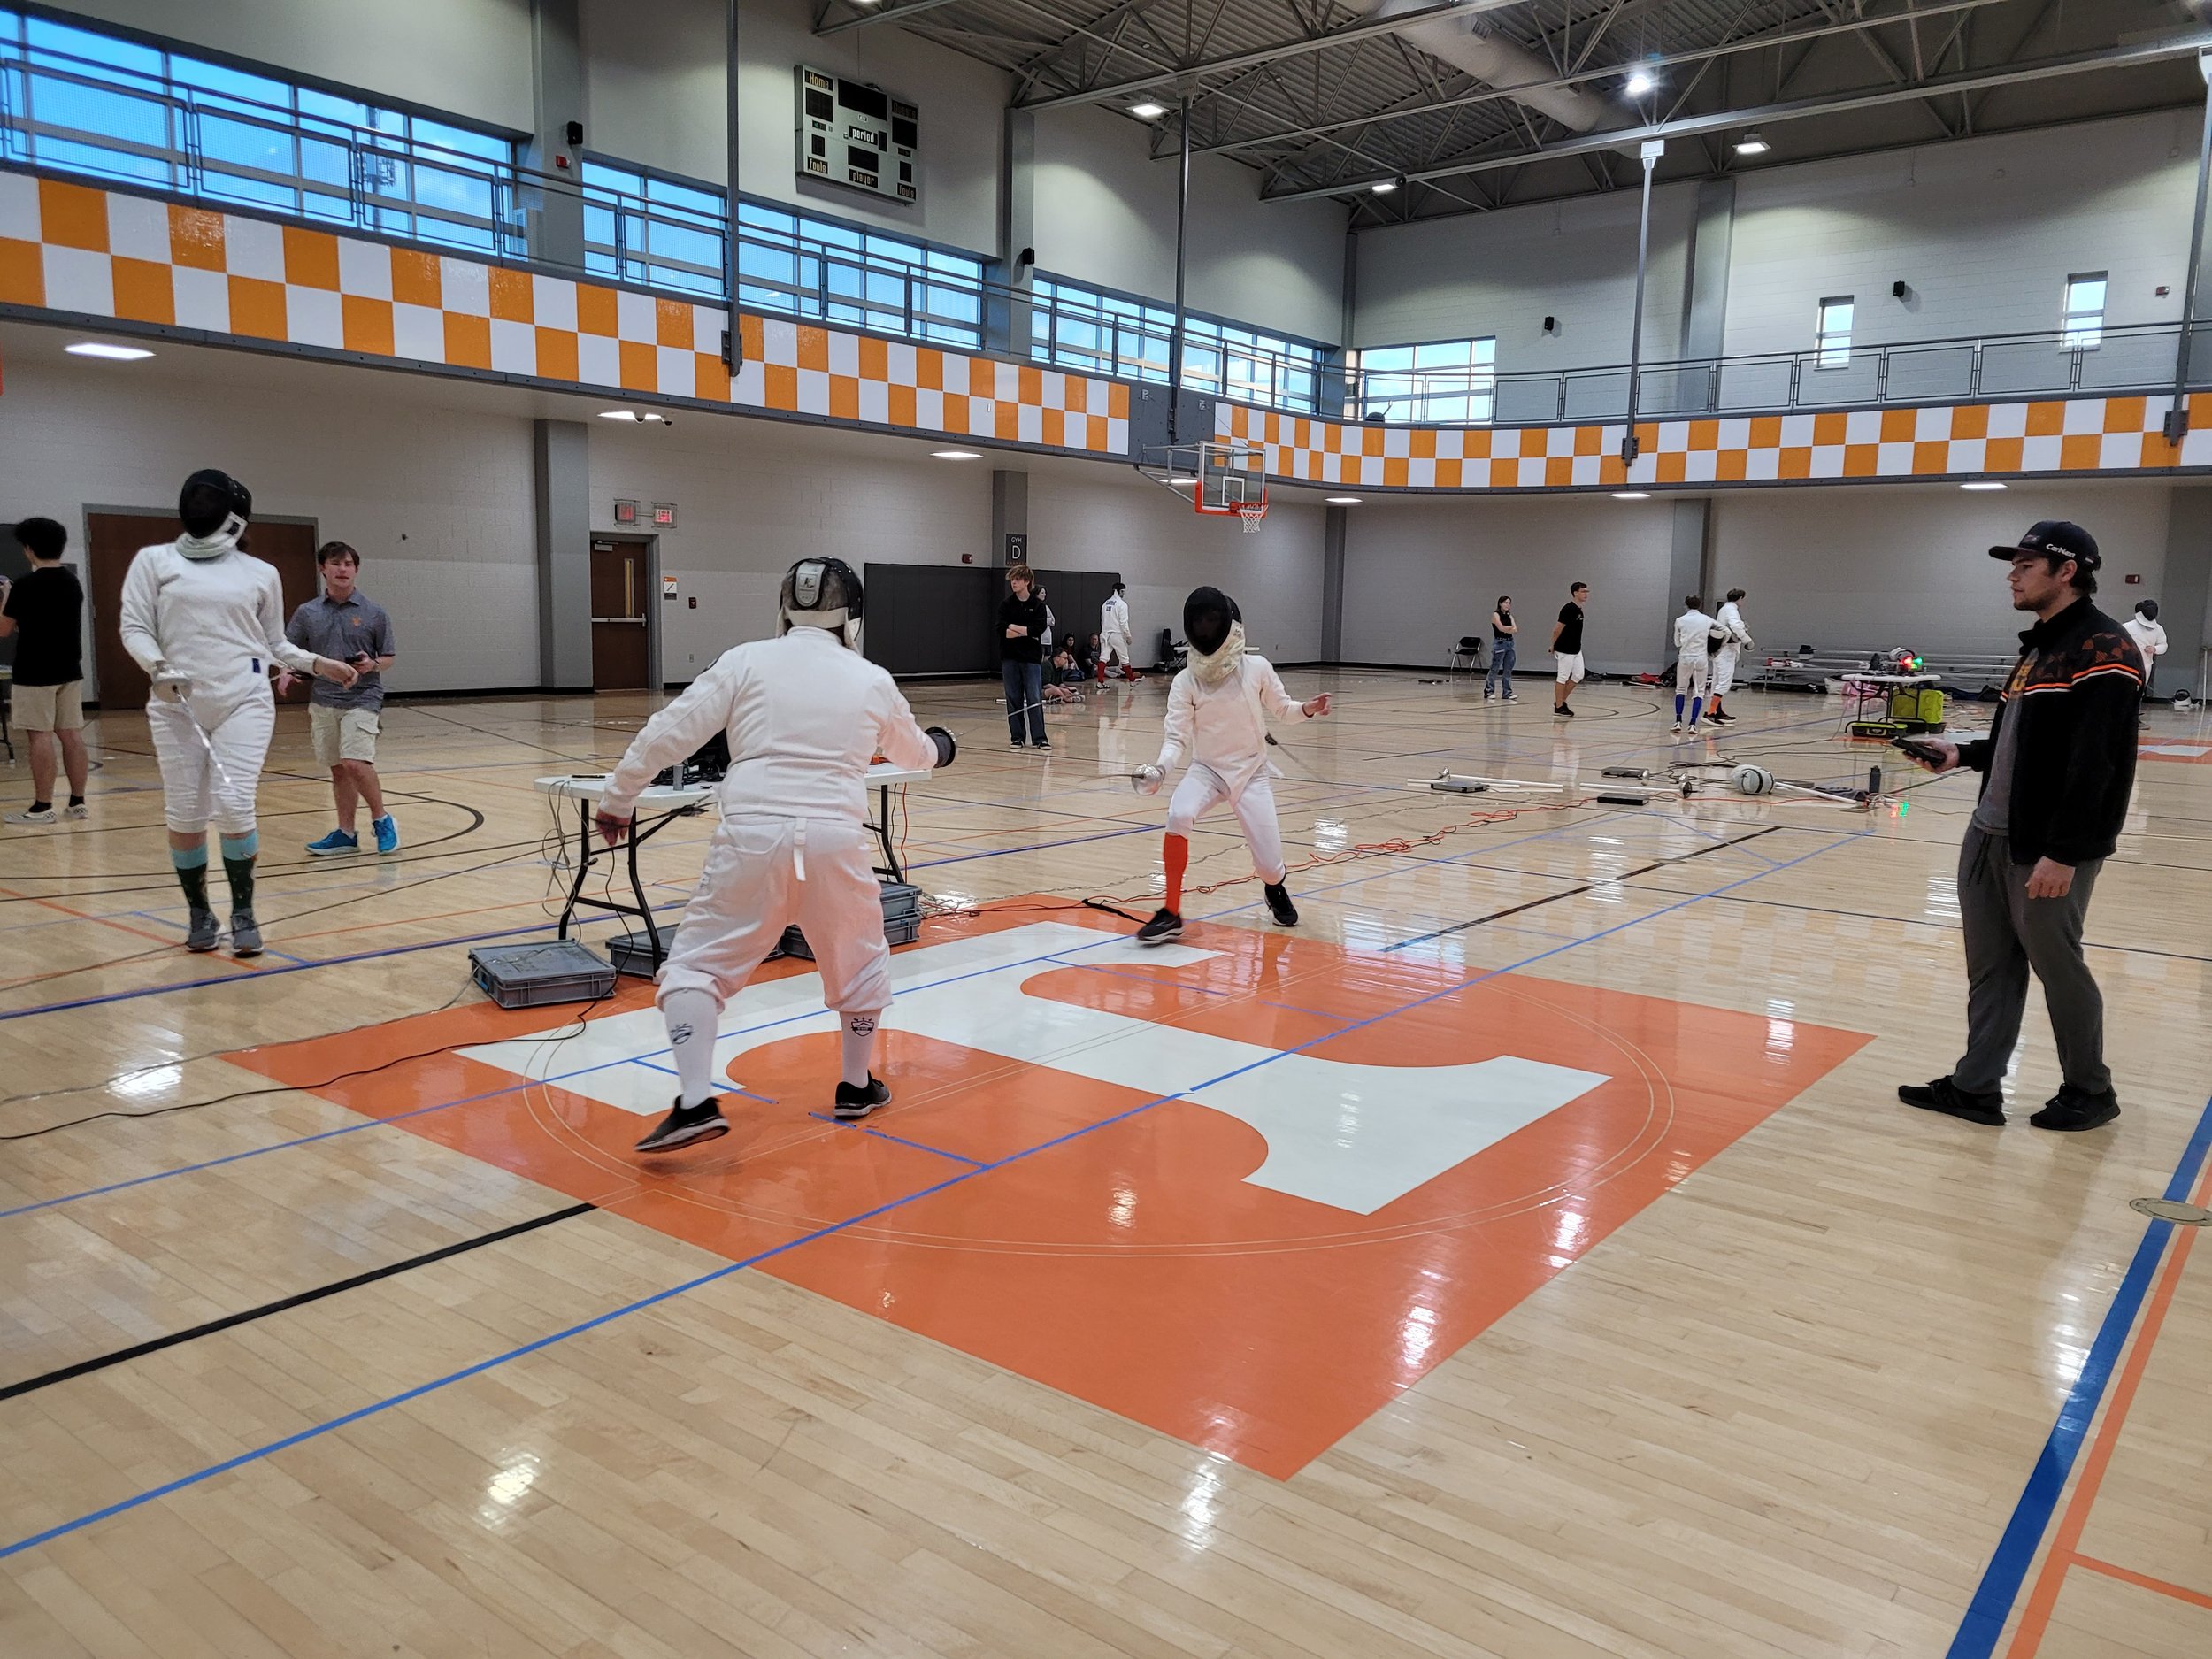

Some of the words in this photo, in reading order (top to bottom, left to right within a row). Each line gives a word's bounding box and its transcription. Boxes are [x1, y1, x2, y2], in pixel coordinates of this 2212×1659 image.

[809, 72, 829, 89] Home
[852, 127, 874, 143] period
[809, 157, 826, 173] fouls
[852, 172, 875, 186] player
[898, 184, 915, 198] fouls
[1011, 545, 1021, 559] D
